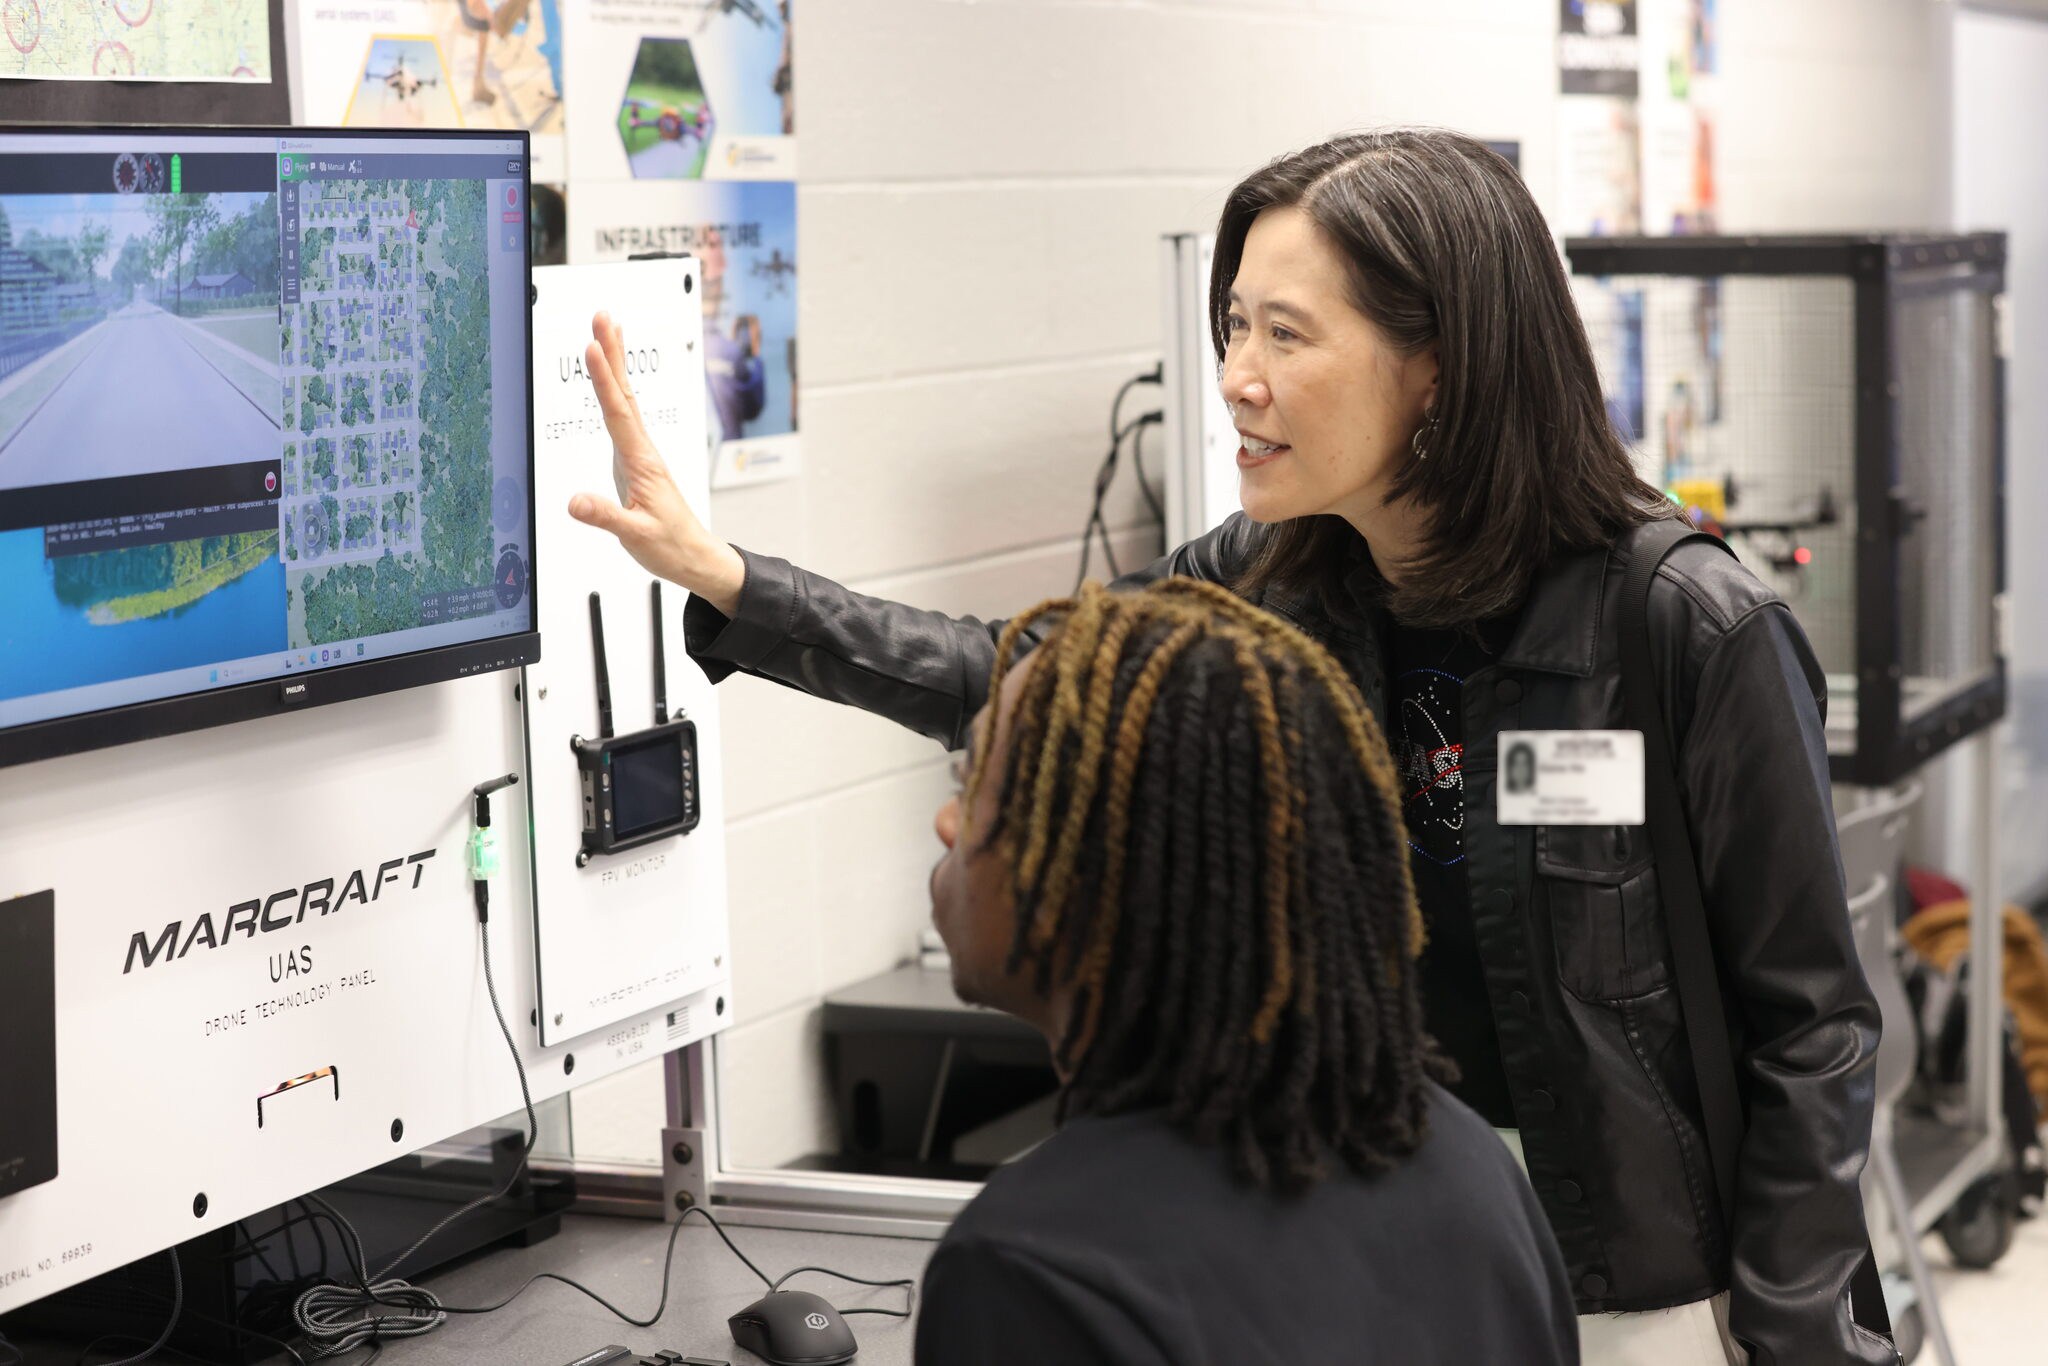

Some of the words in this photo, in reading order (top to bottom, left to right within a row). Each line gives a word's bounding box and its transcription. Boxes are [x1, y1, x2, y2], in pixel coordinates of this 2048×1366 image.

[286, 684, 305, 695] PHILIPS
[602, 869, 620, 887] FPV
[625, 854, 666, 878] MONITOR
[123, 848, 437, 974] MARCRAFT
[269, 945, 312, 983] UAS
[205, 1009, 247, 1037] DRONE
[255, 981, 332, 1019] TECHNOLOGY
[340, 969, 376, 990] PANEL
[0, 1266, 31, 1288] SERIAL
